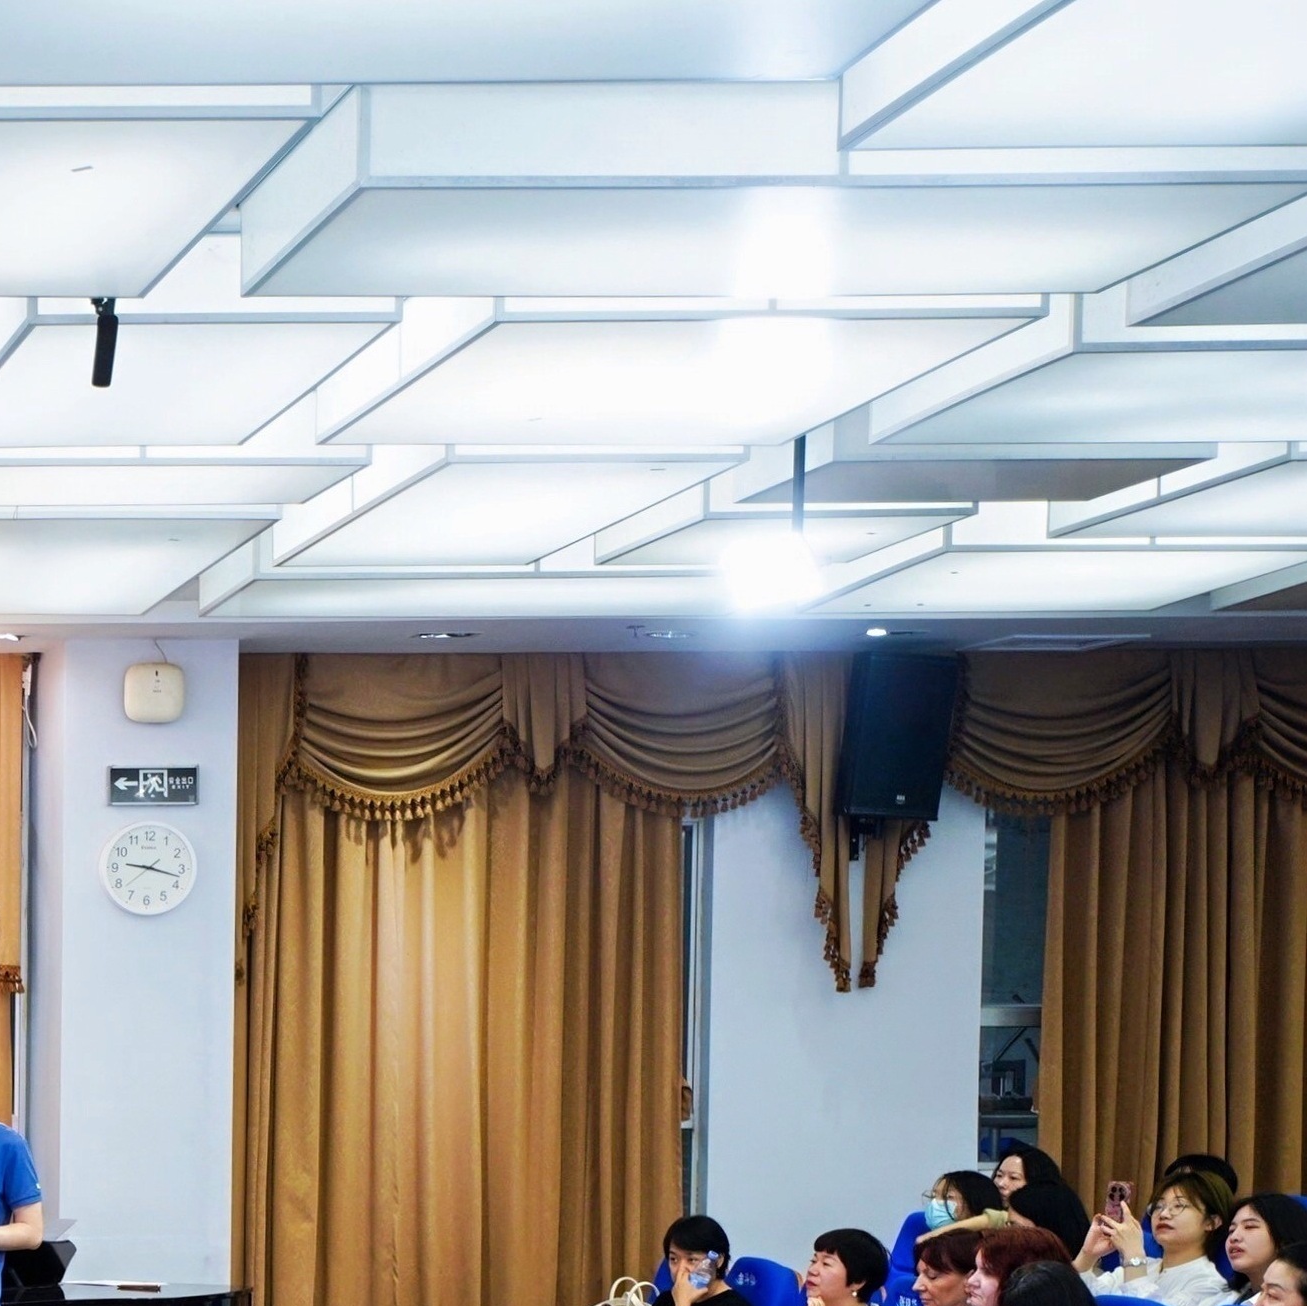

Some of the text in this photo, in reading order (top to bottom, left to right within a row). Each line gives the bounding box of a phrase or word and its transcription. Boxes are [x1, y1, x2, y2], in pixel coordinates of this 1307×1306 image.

[129, 835, 139, 845] 11
[145, 831, 156, 841] 12
[164, 836, 169, 845] 1
[116, 847, 128, 857] 10
[174, 848, 181, 858] 2
[111, 863, 119, 872] 9
[178, 864, 185, 874] 3
[115, 878, 122, 888] 8
[172, 880, 179, 889] 4
[128, 890, 135, 900] 7
[160, 891, 167, 901] 5
[143, 896, 150, 905] 6
